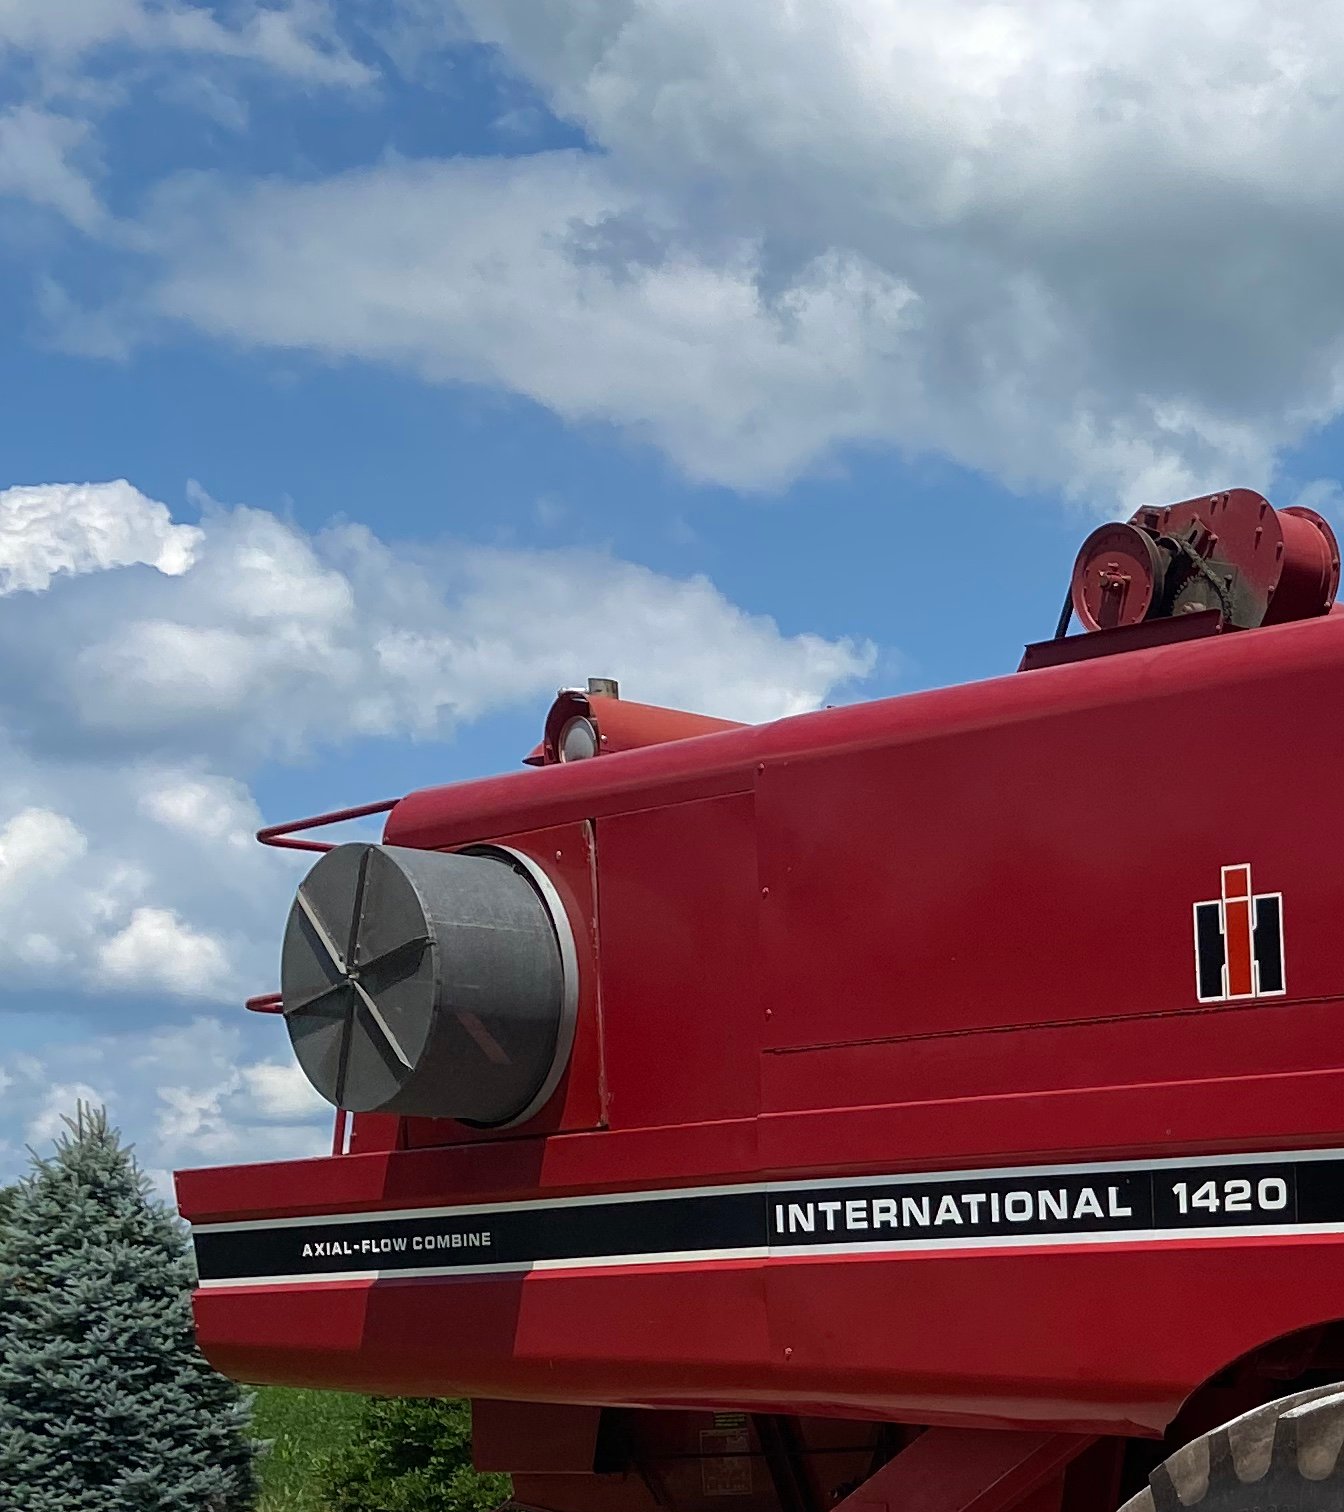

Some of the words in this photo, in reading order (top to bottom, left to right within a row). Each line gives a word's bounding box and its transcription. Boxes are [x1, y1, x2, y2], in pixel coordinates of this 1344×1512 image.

[776, 1187, 1132, 1232] INTERNATIONAL
[1172, 1178, 1287, 1214] 1420
[302, 1238, 407, 1257] AXIAL-FLOW
[413, 1232, 491, 1250] COMBINE
